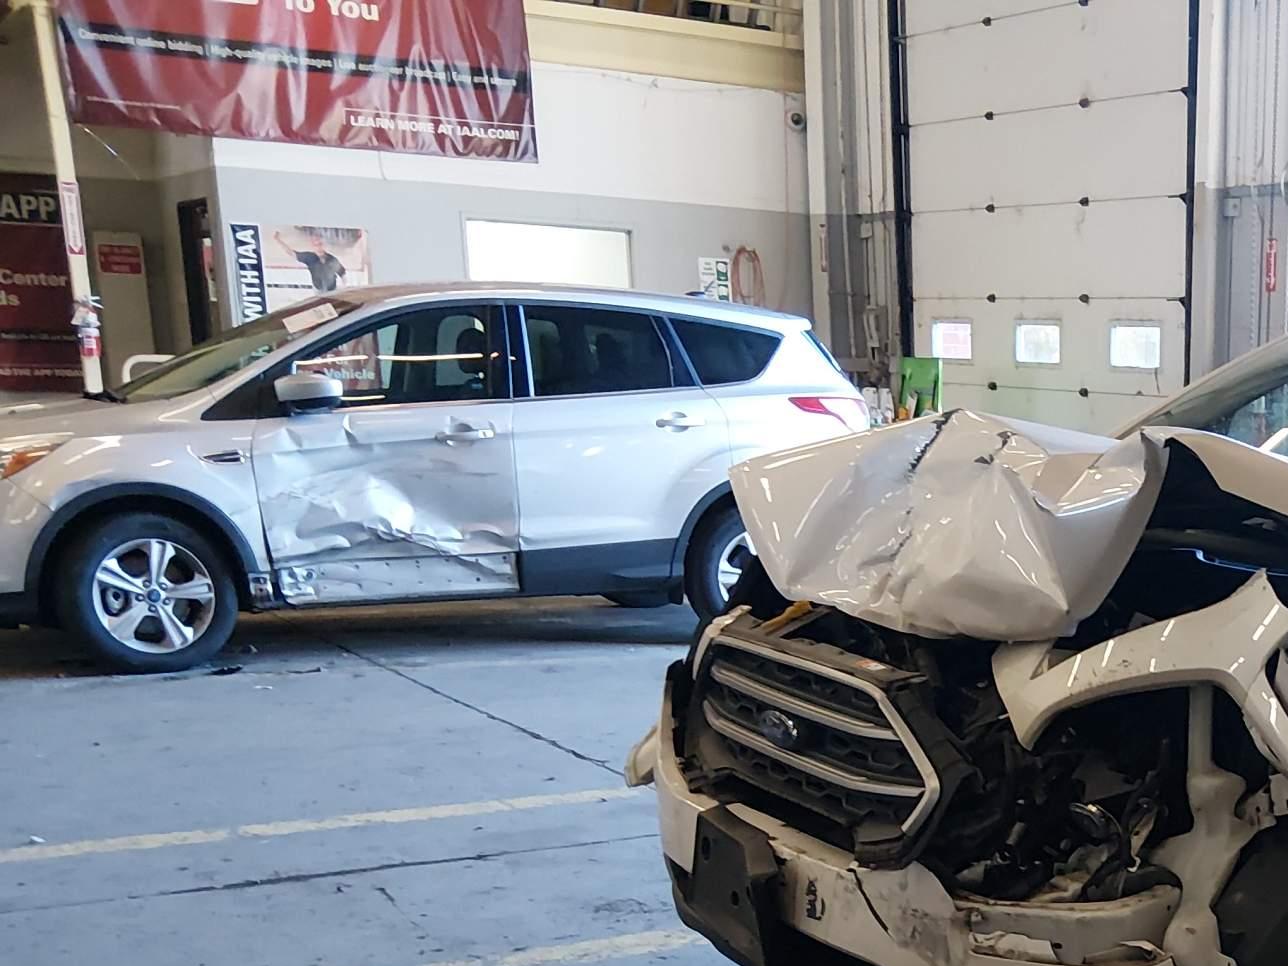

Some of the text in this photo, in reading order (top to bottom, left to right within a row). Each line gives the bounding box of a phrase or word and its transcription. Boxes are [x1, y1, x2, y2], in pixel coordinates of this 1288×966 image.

[327, 0, 379, 21] You
[350, 115, 395, 129] LEARN
[397, 119, 435, 134] MORE
[437, 125, 455, 136] AT
[0, 194, 56, 220] APP
[0, 268, 67, 287] Center
[235, 229, 264, 321] WITH IAA
[324, 367, 375, 380] Vehicle
